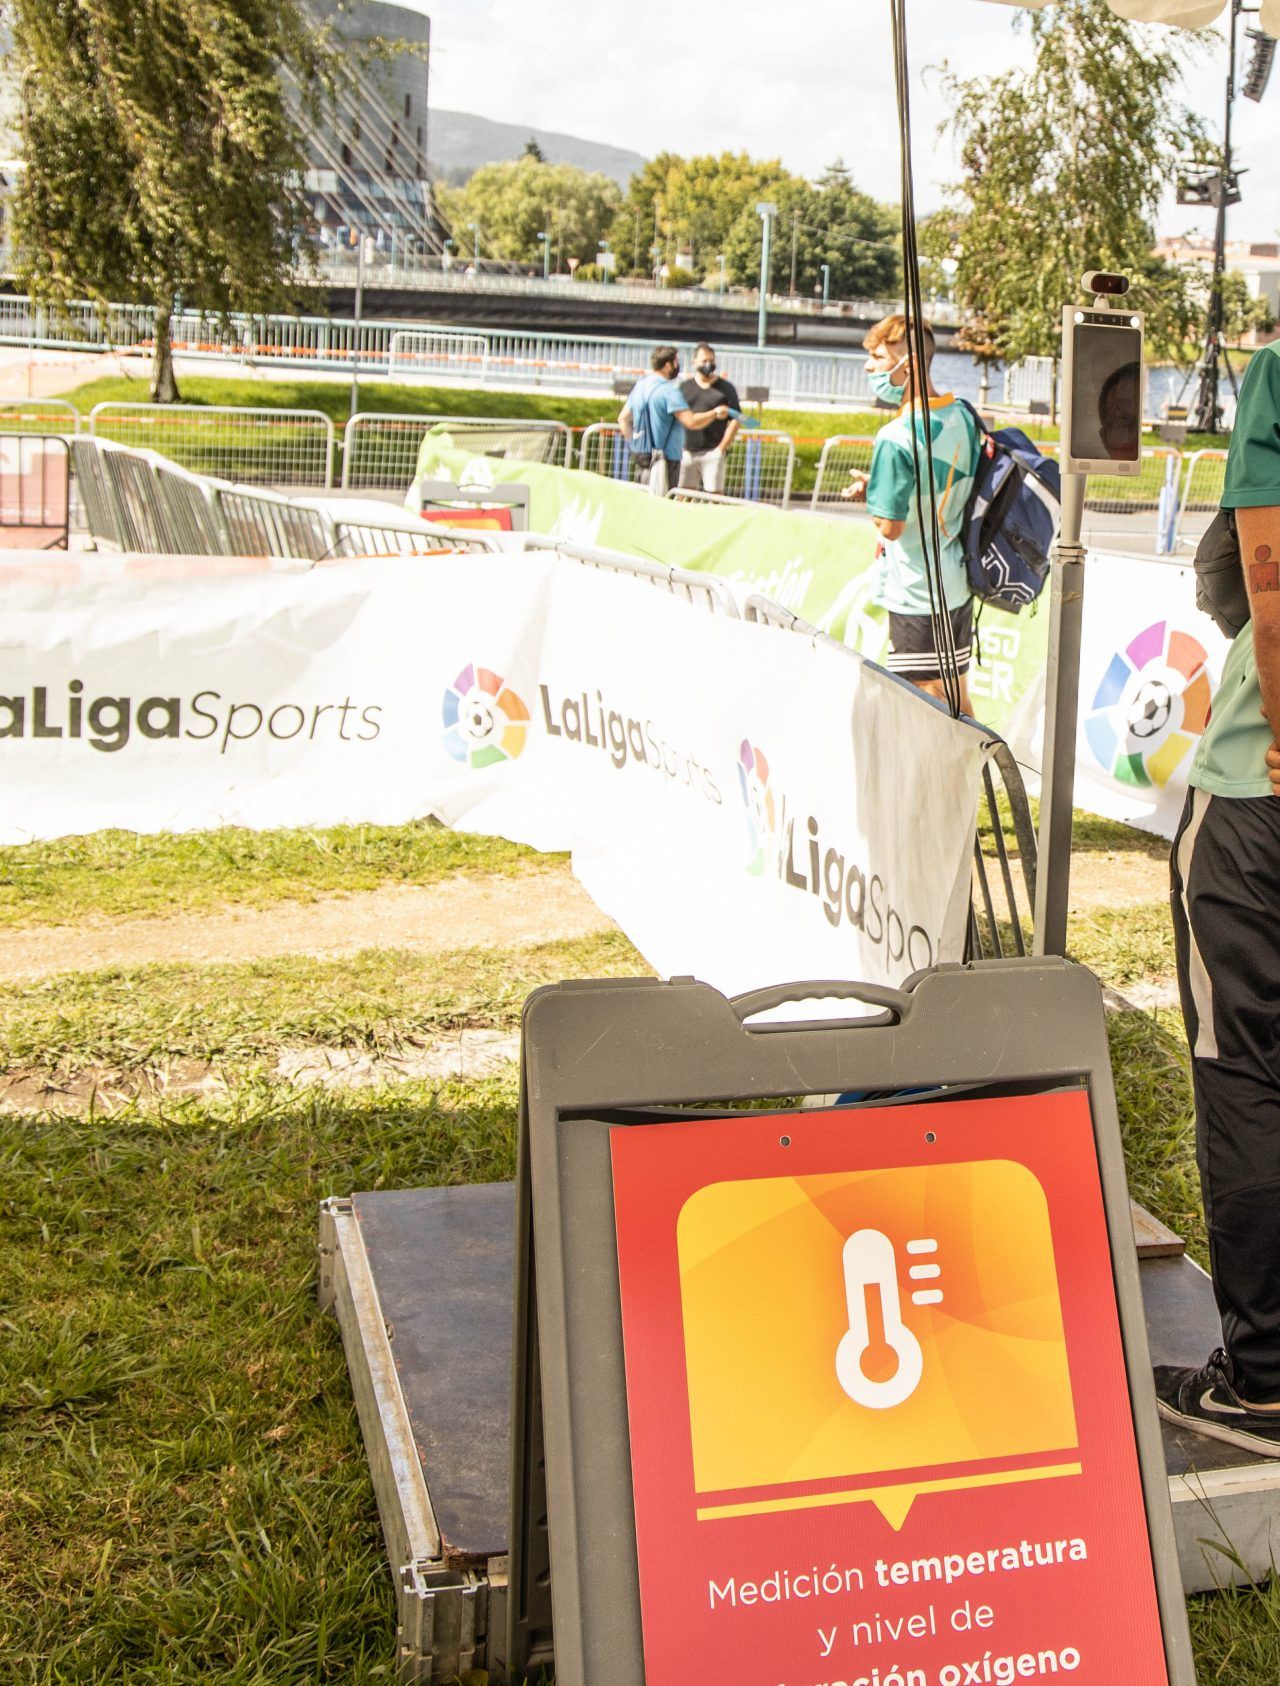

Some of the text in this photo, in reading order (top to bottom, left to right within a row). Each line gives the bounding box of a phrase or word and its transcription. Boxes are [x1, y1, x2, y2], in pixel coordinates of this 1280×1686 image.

[708, 1537, 1089, 1609] Medición temperatura
[817, 1600, 995, 1657] y nivel de
[939, 1646, 1081, 1686] oxígeno
